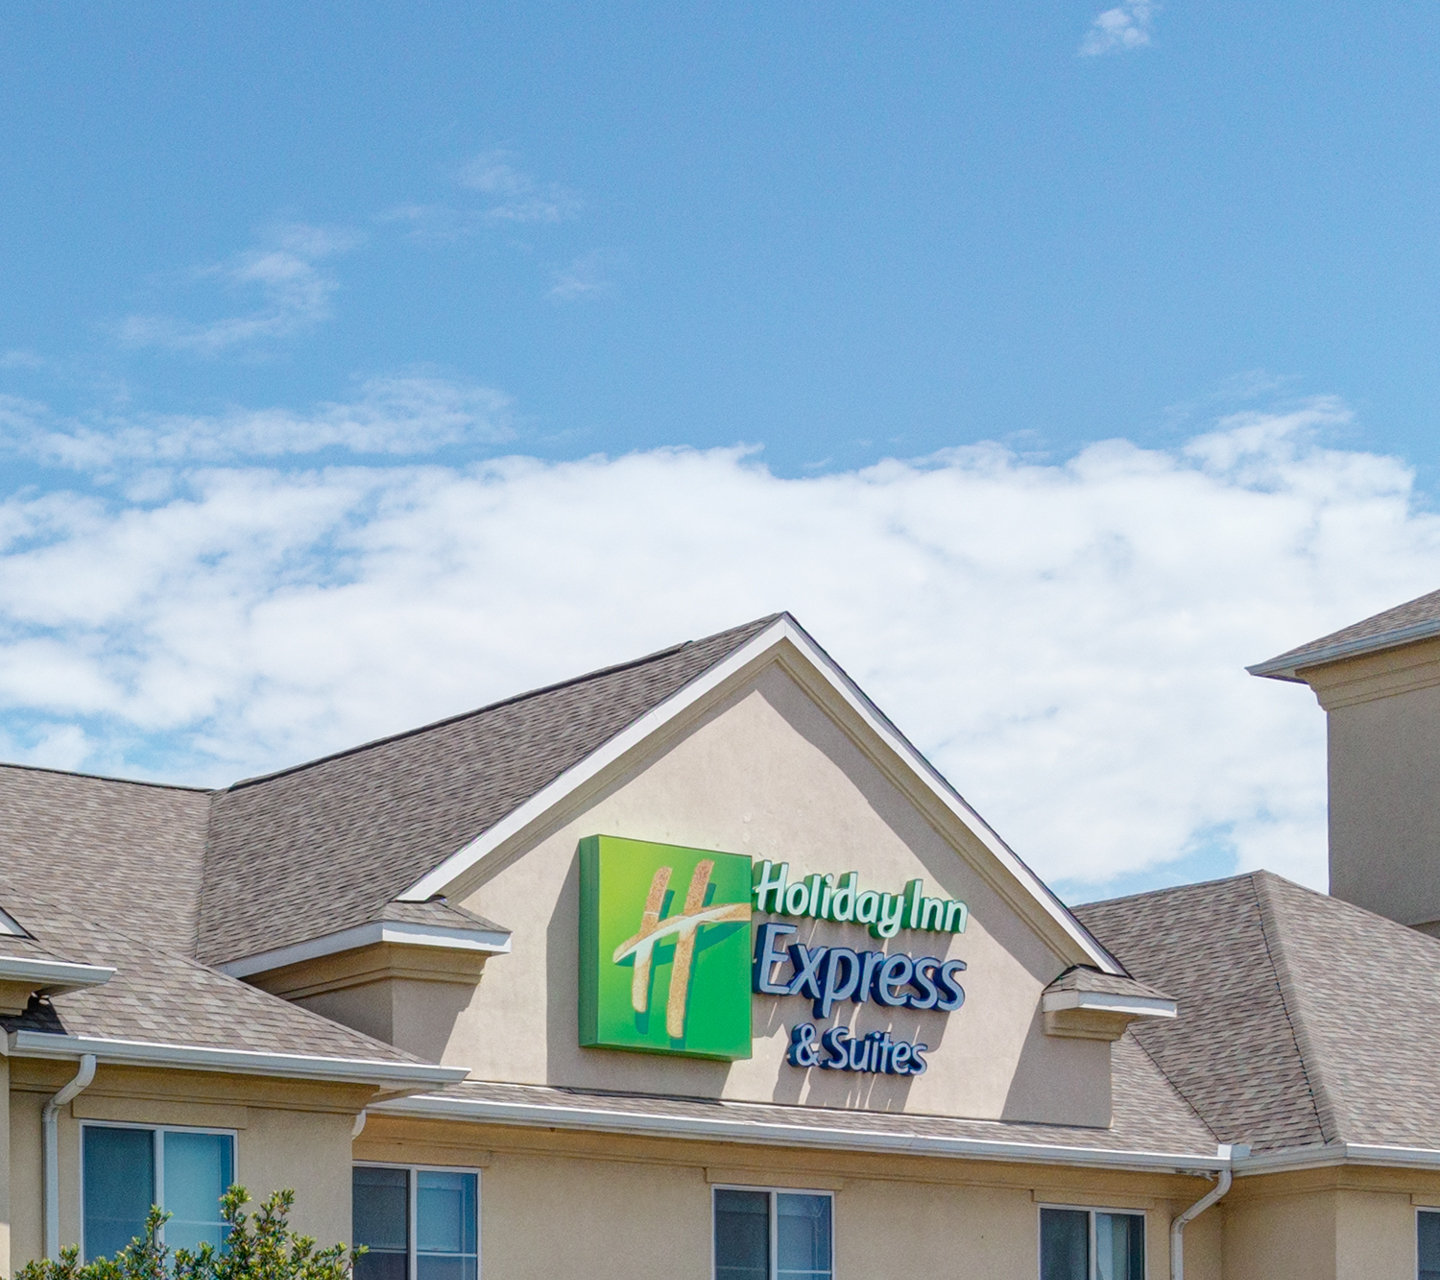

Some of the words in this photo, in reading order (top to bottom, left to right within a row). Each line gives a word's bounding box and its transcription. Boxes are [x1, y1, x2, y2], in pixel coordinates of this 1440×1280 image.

[755, 860, 905, 939] Holiday
[905, 879, 969, 934] Inn
[752, 922, 968, 1019] Express
[790, 1022, 820, 1068] &
[822, 1025, 928, 1076] Suites
